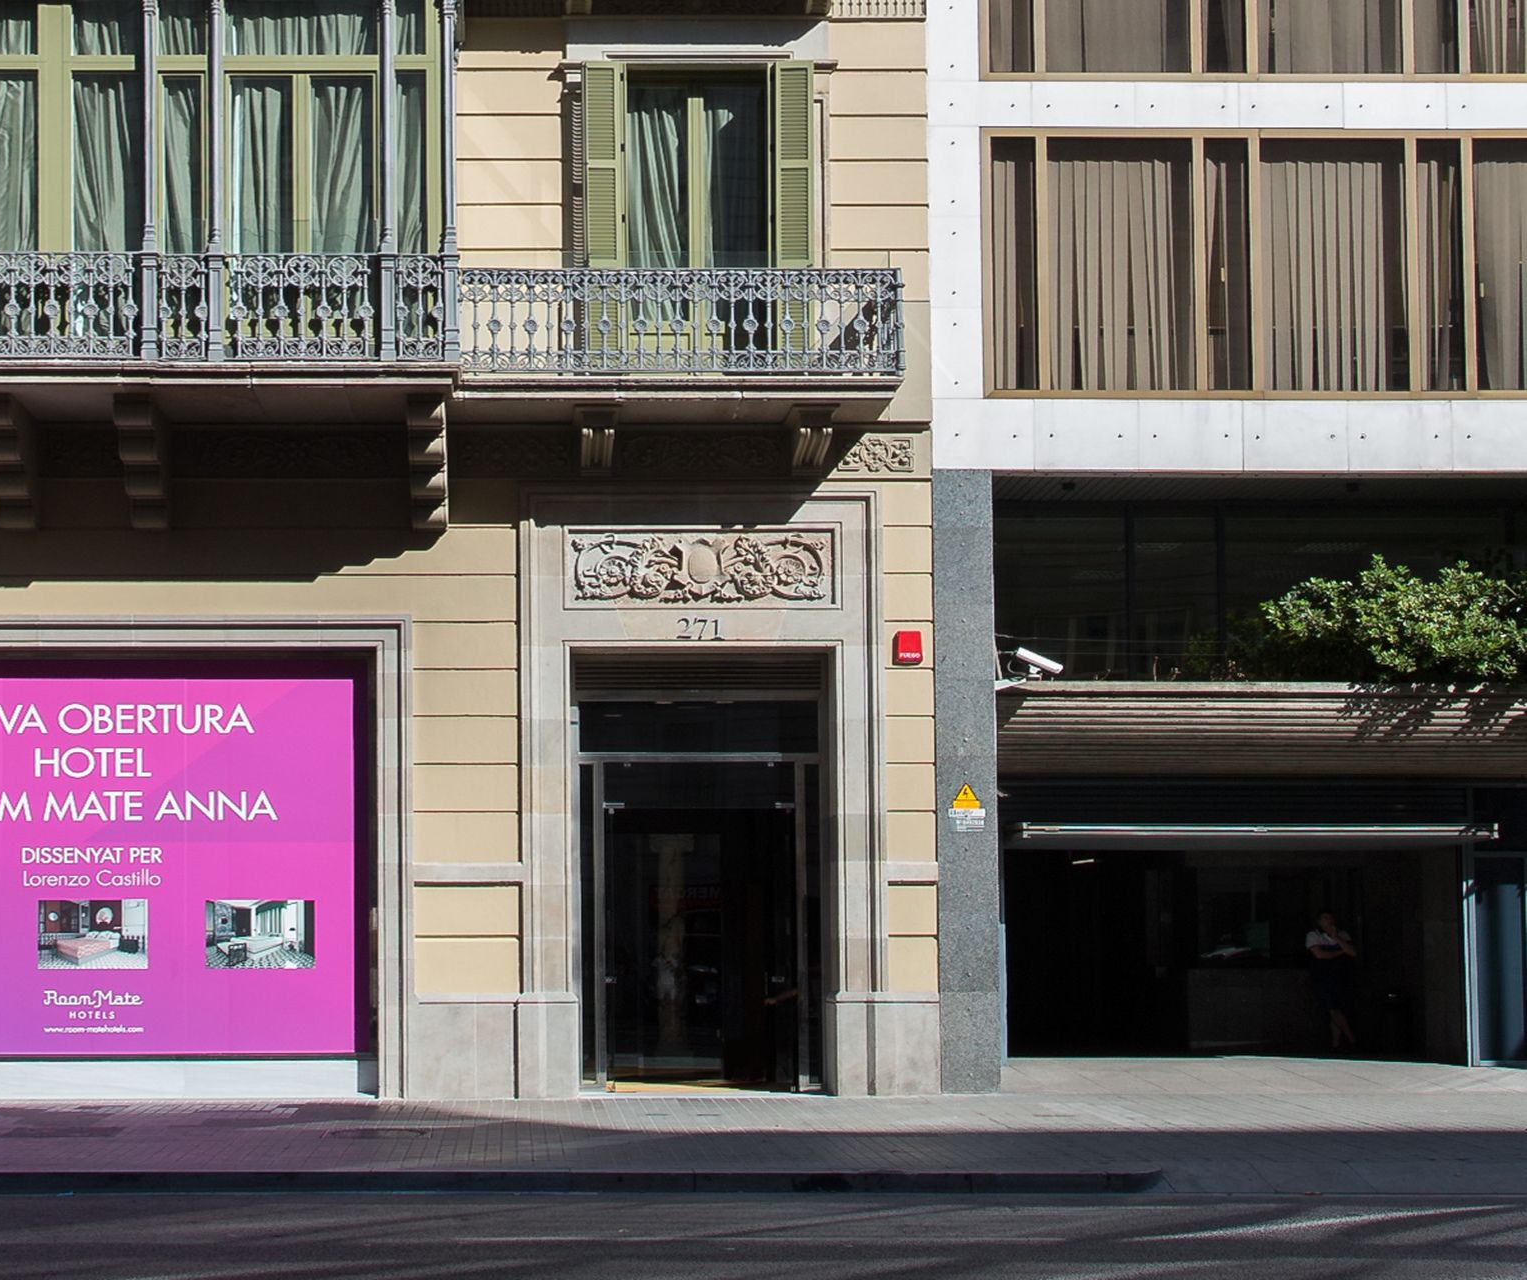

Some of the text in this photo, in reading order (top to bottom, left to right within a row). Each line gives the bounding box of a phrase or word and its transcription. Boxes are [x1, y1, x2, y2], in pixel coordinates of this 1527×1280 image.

[676, 617, 725, 641] 271
[57, 703, 255, 735] OBERTURA
[34, 747, 152, 778] HOTEL
[42, 790, 144, 822] MATE
[154, 790, 278, 821] ANNA
[21, 847, 163, 864] DISSENYAT PER
[22, 868, 162, 887] Lorenzo Castillo
[43, 989, 144, 1008] Room Mate
[68, 1010, 116, 1020] HOTELS
